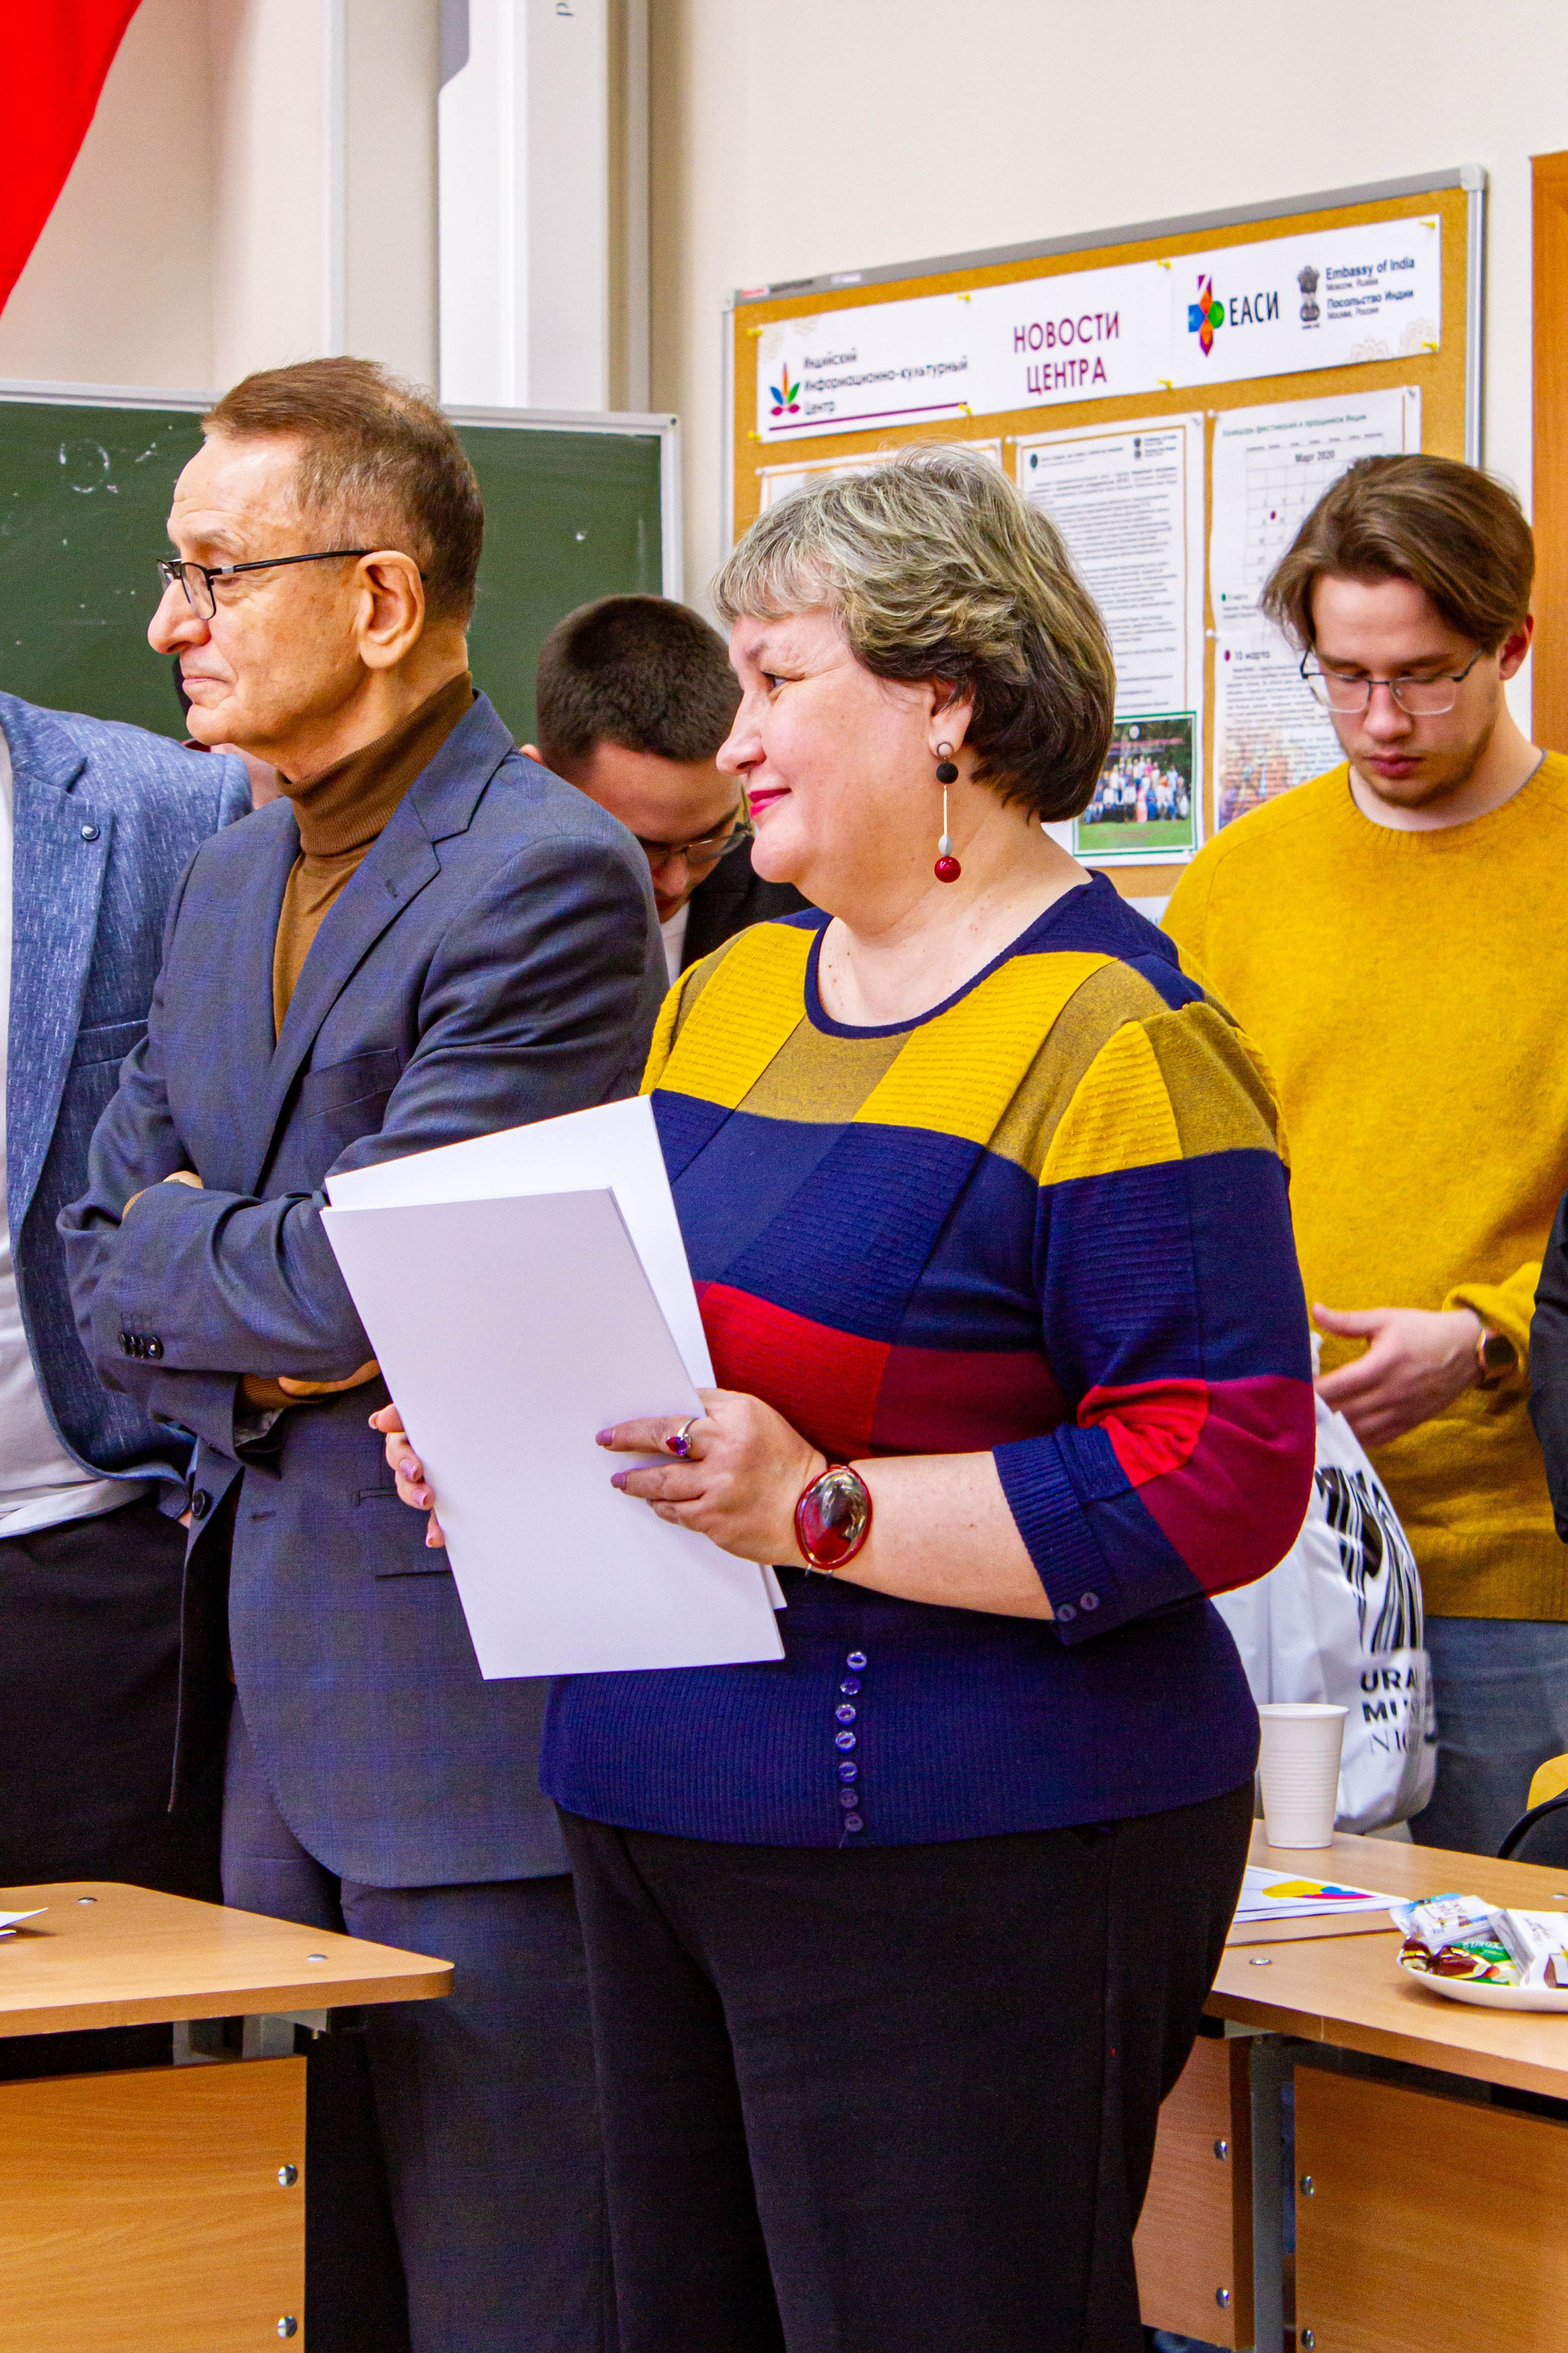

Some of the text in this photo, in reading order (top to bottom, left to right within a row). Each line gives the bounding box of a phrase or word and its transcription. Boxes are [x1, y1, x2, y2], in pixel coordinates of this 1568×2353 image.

[1326, 255, 1415, 281] Embassy of India
[1230, 291, 1280, 326] ЕАСИ
[1327, 289, 1414, 308] Посольство Индии
[1013, 311, 1119, 353] НОВОСТИ
[804, 355, 968, 392] Информационно-культурный
[1027, 356, 1107, 396] ЦЕНТРА
[804, 401, 835, 416] Центр
[1295, 450, 1334, 464] Март 2020
[1245, 651, 1270, 660] марта
[1360, 1667, 1418, 1693] URA
